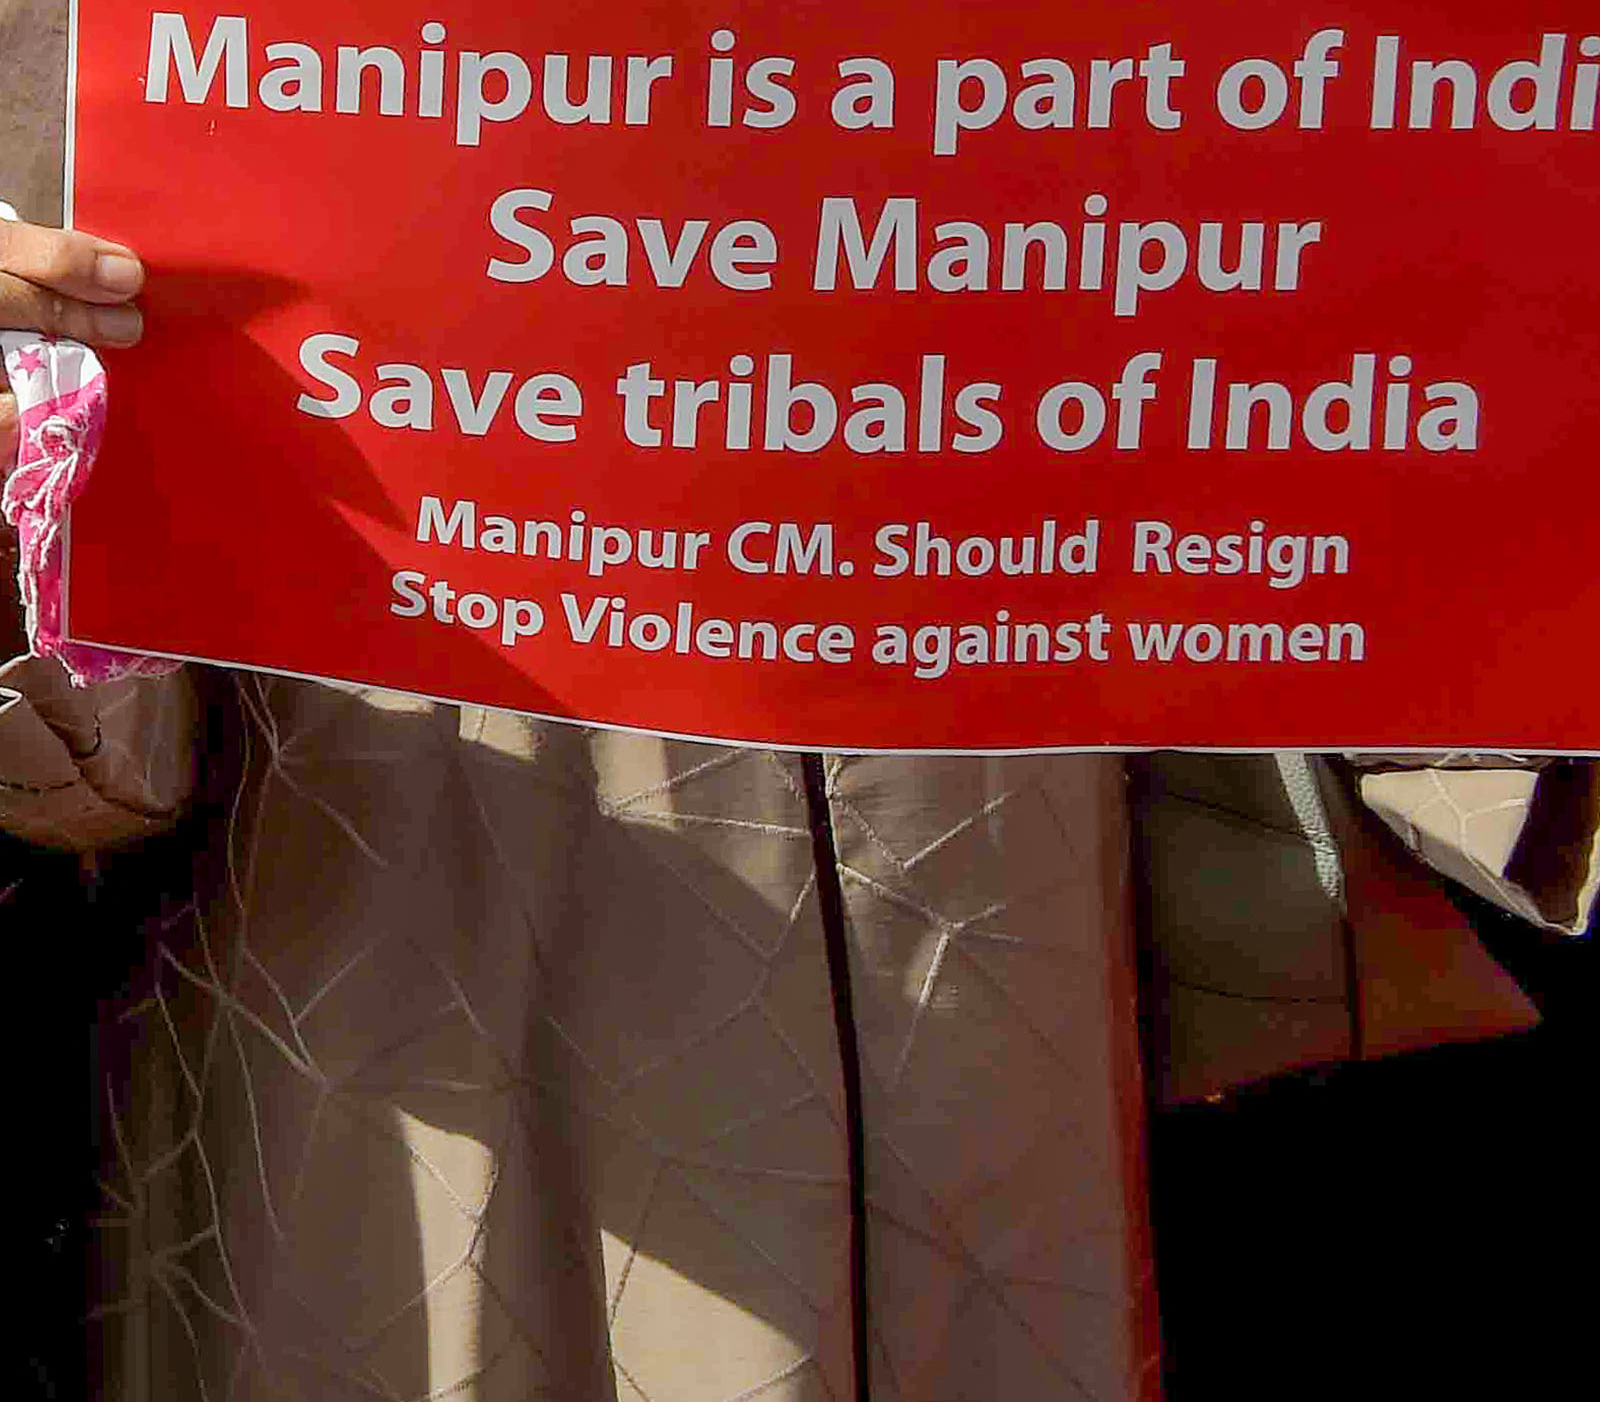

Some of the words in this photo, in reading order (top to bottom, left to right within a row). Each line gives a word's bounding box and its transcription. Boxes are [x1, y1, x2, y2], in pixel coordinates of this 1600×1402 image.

[146, 13, 672, 145] Manipur
[708, 30, 796, 128] is
[832, 58, 894, 129] a
[934, 43, 1185, 155] part
[1217, 29, 1344, 129] of
[1371, 34, 1600, 130] Indi
[487, 189, 777, 290] Save
[814, 195, 1320, 316] Manipur
[297, 334, 582, 441] Save
[617, 354, 1002, 453] tribals
[1037, 353, 1162, 451] of
[1188, 354, 1478, 451] India
[417, 497, 709, 576] Manipur
[728, 522, 854, 575] CM.
[874, 520, 1098, 576] Should
[1133, 521, 1348, 588] Resign
[391, 571, 543, 646] Stop
[561, 594, 854, 663] Violence
[872, 610, 1111, 678] against
[1128, 623, 1364, 662] women
